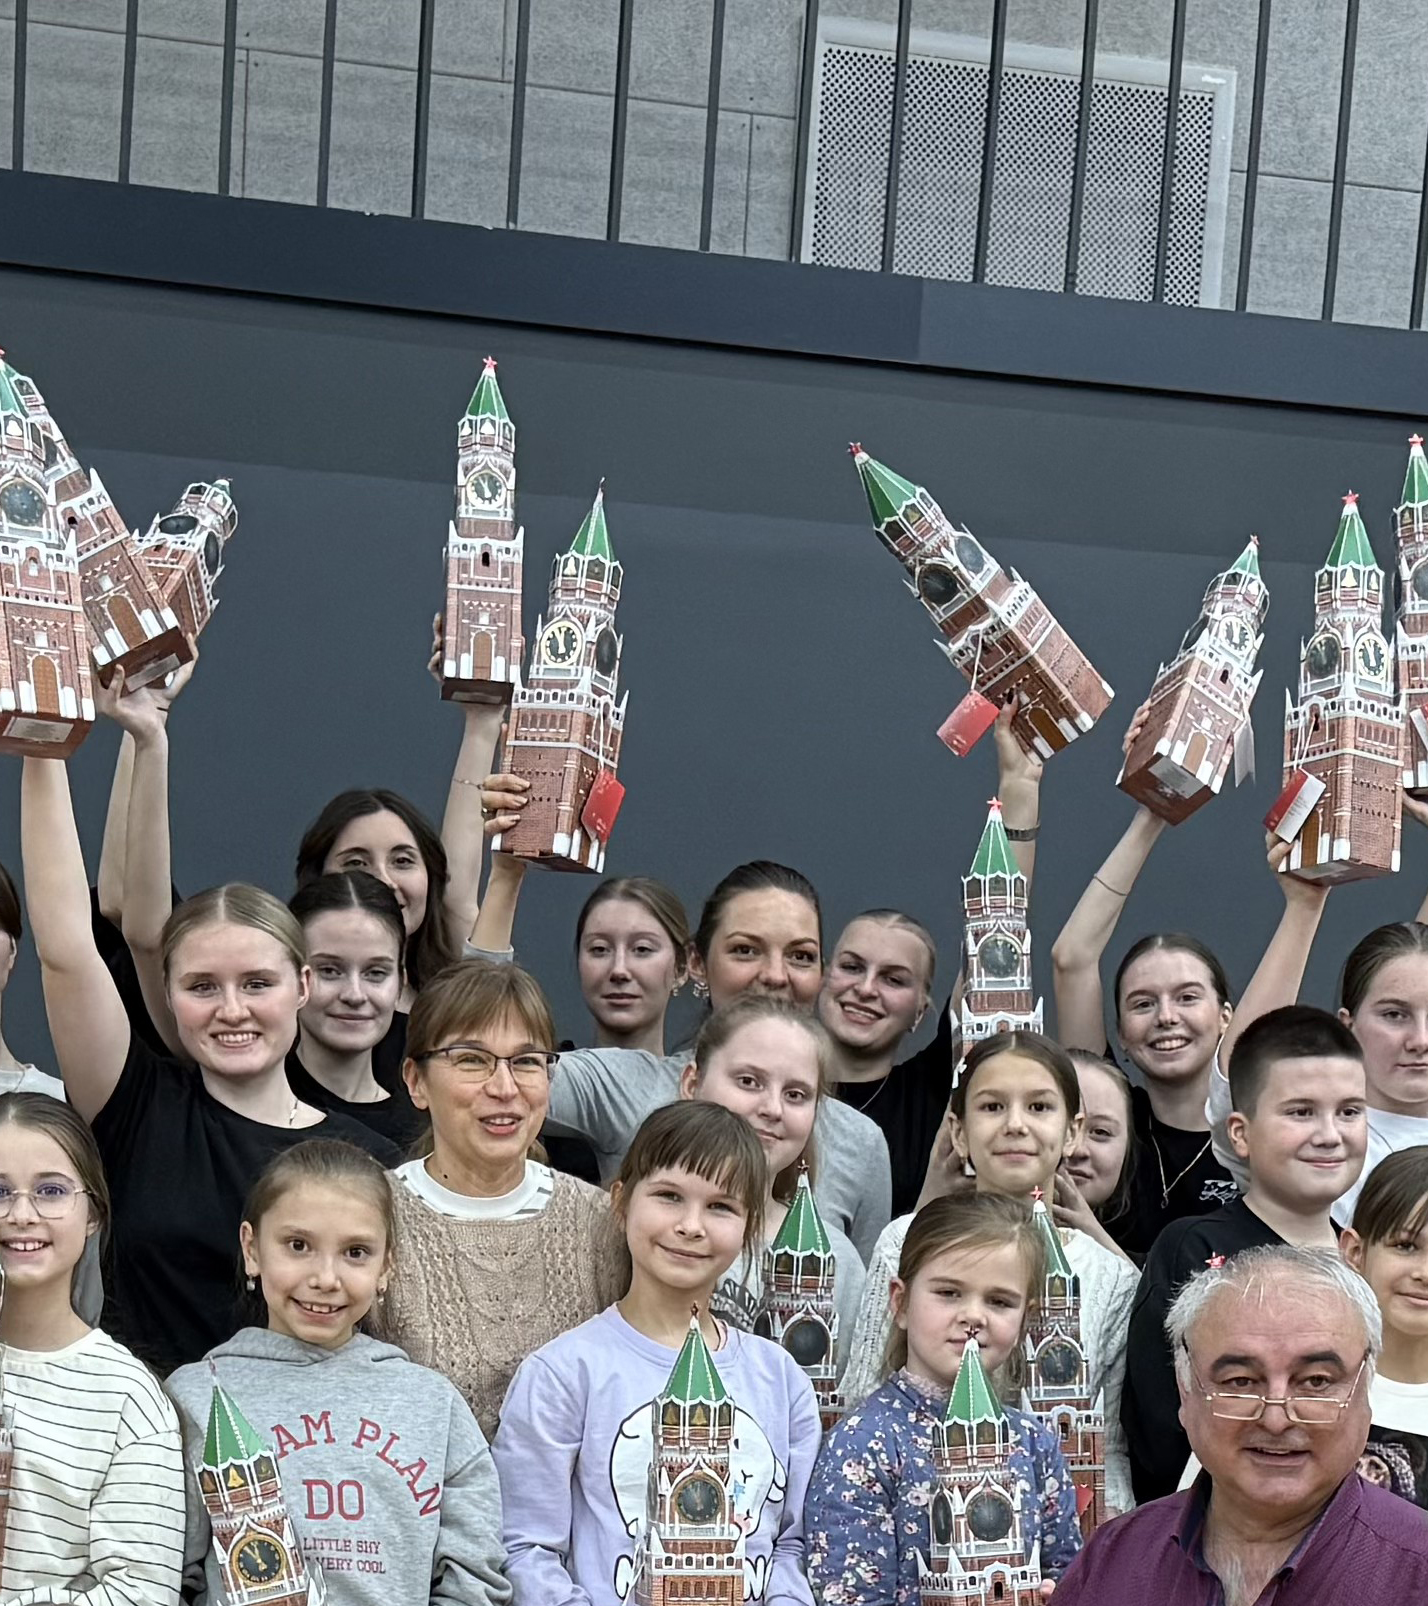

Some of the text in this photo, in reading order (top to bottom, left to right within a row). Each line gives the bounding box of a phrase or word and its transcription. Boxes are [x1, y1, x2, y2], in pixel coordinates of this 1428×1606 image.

[270, 1410, 441, 1517] AM PLAN
[301, 1478, 365, 1521] DO
[303, 1537, 382, 1555] LITTLE SHY
[315, 1556, 353, 1572] VERY
[356, 1560, 387, 1574] COOL
